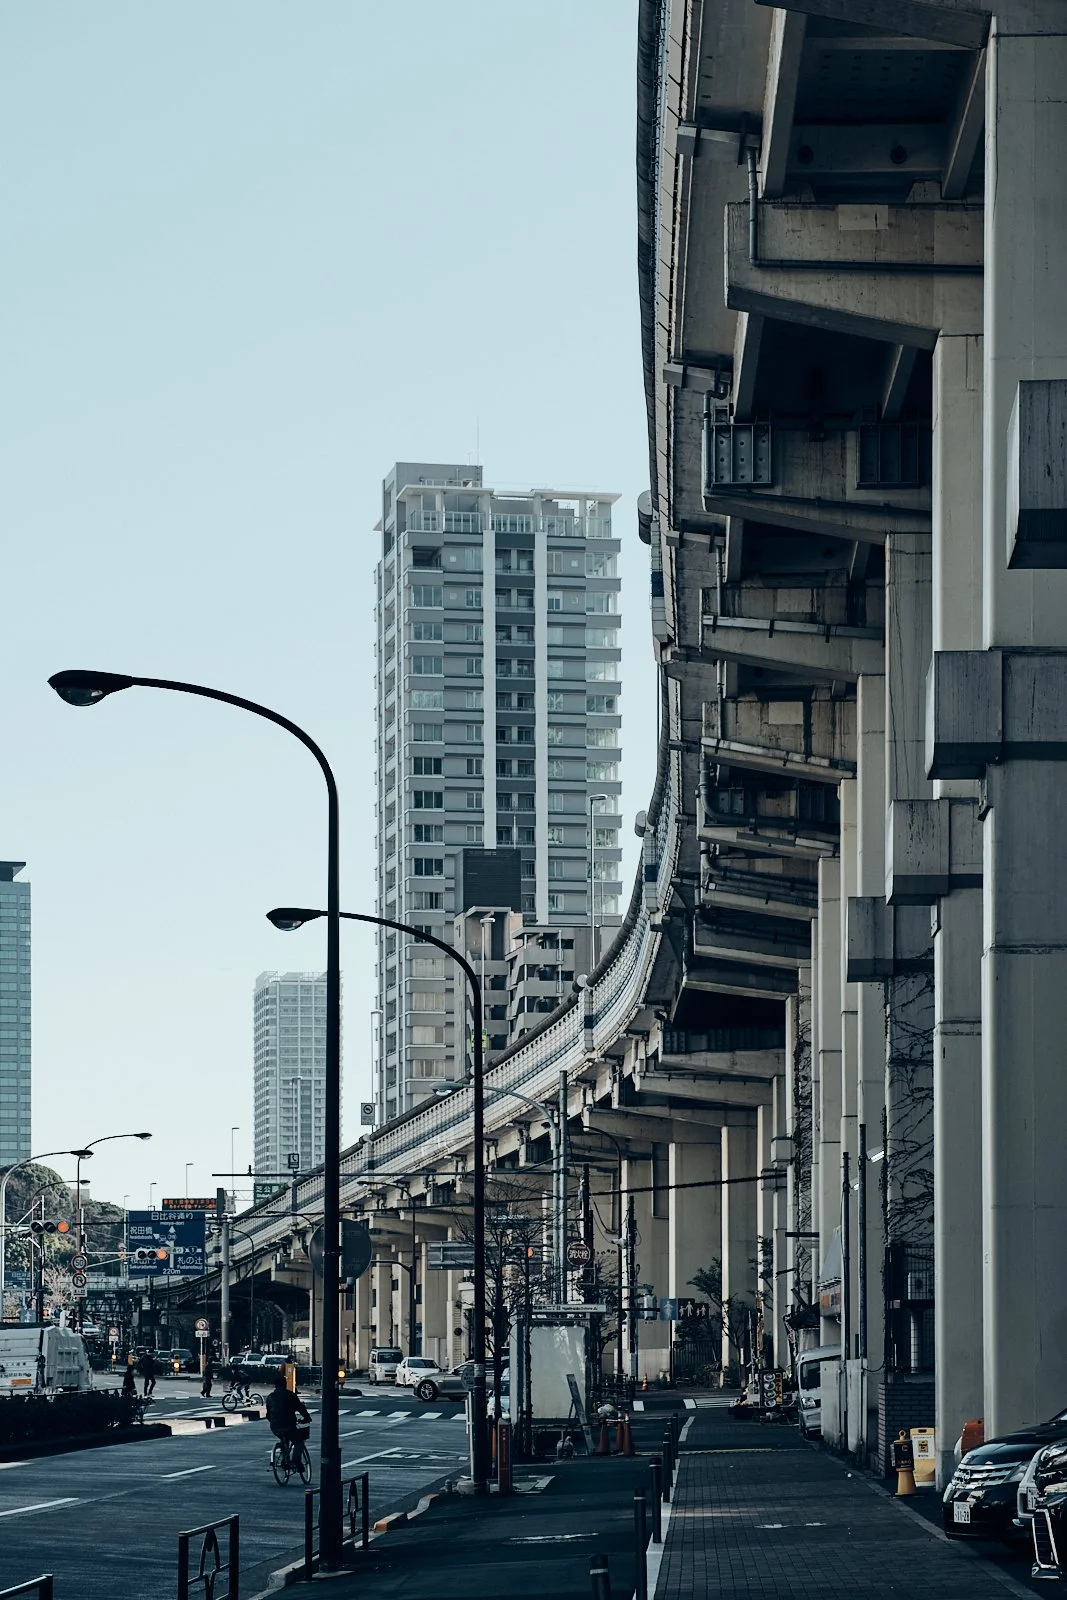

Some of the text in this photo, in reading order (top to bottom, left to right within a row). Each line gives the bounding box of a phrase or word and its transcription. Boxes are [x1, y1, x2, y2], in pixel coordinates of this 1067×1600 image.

[130, 1226, 152, 1234] 祝田橋
[569, 1250, 588, 1259] 消火栓
[177, 1256, 203, 1264] 札の辻
